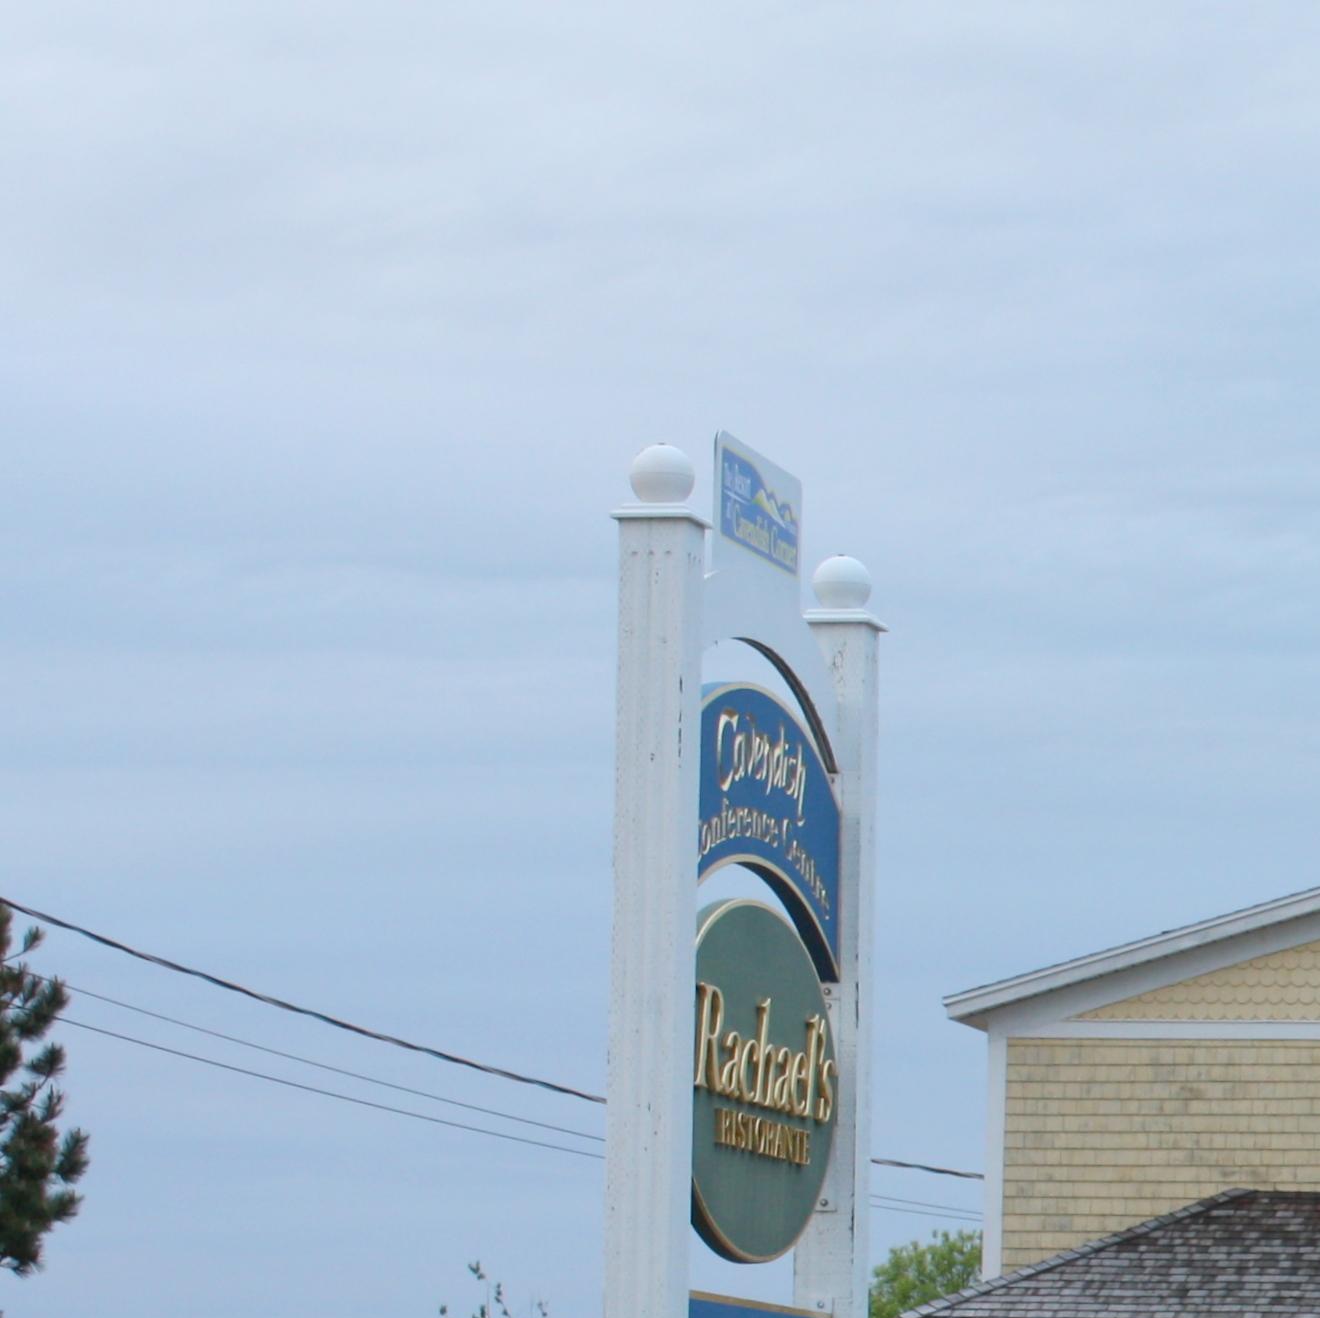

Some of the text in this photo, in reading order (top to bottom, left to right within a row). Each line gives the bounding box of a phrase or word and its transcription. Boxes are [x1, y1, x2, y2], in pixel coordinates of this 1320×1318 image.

[717, 708, 806, 826] Cavendish
[698, 797, 780, 862] onference
[694, 981, 836, 1123] Rachael's
[715, 1108, 811, 1165] RISTORANTE
